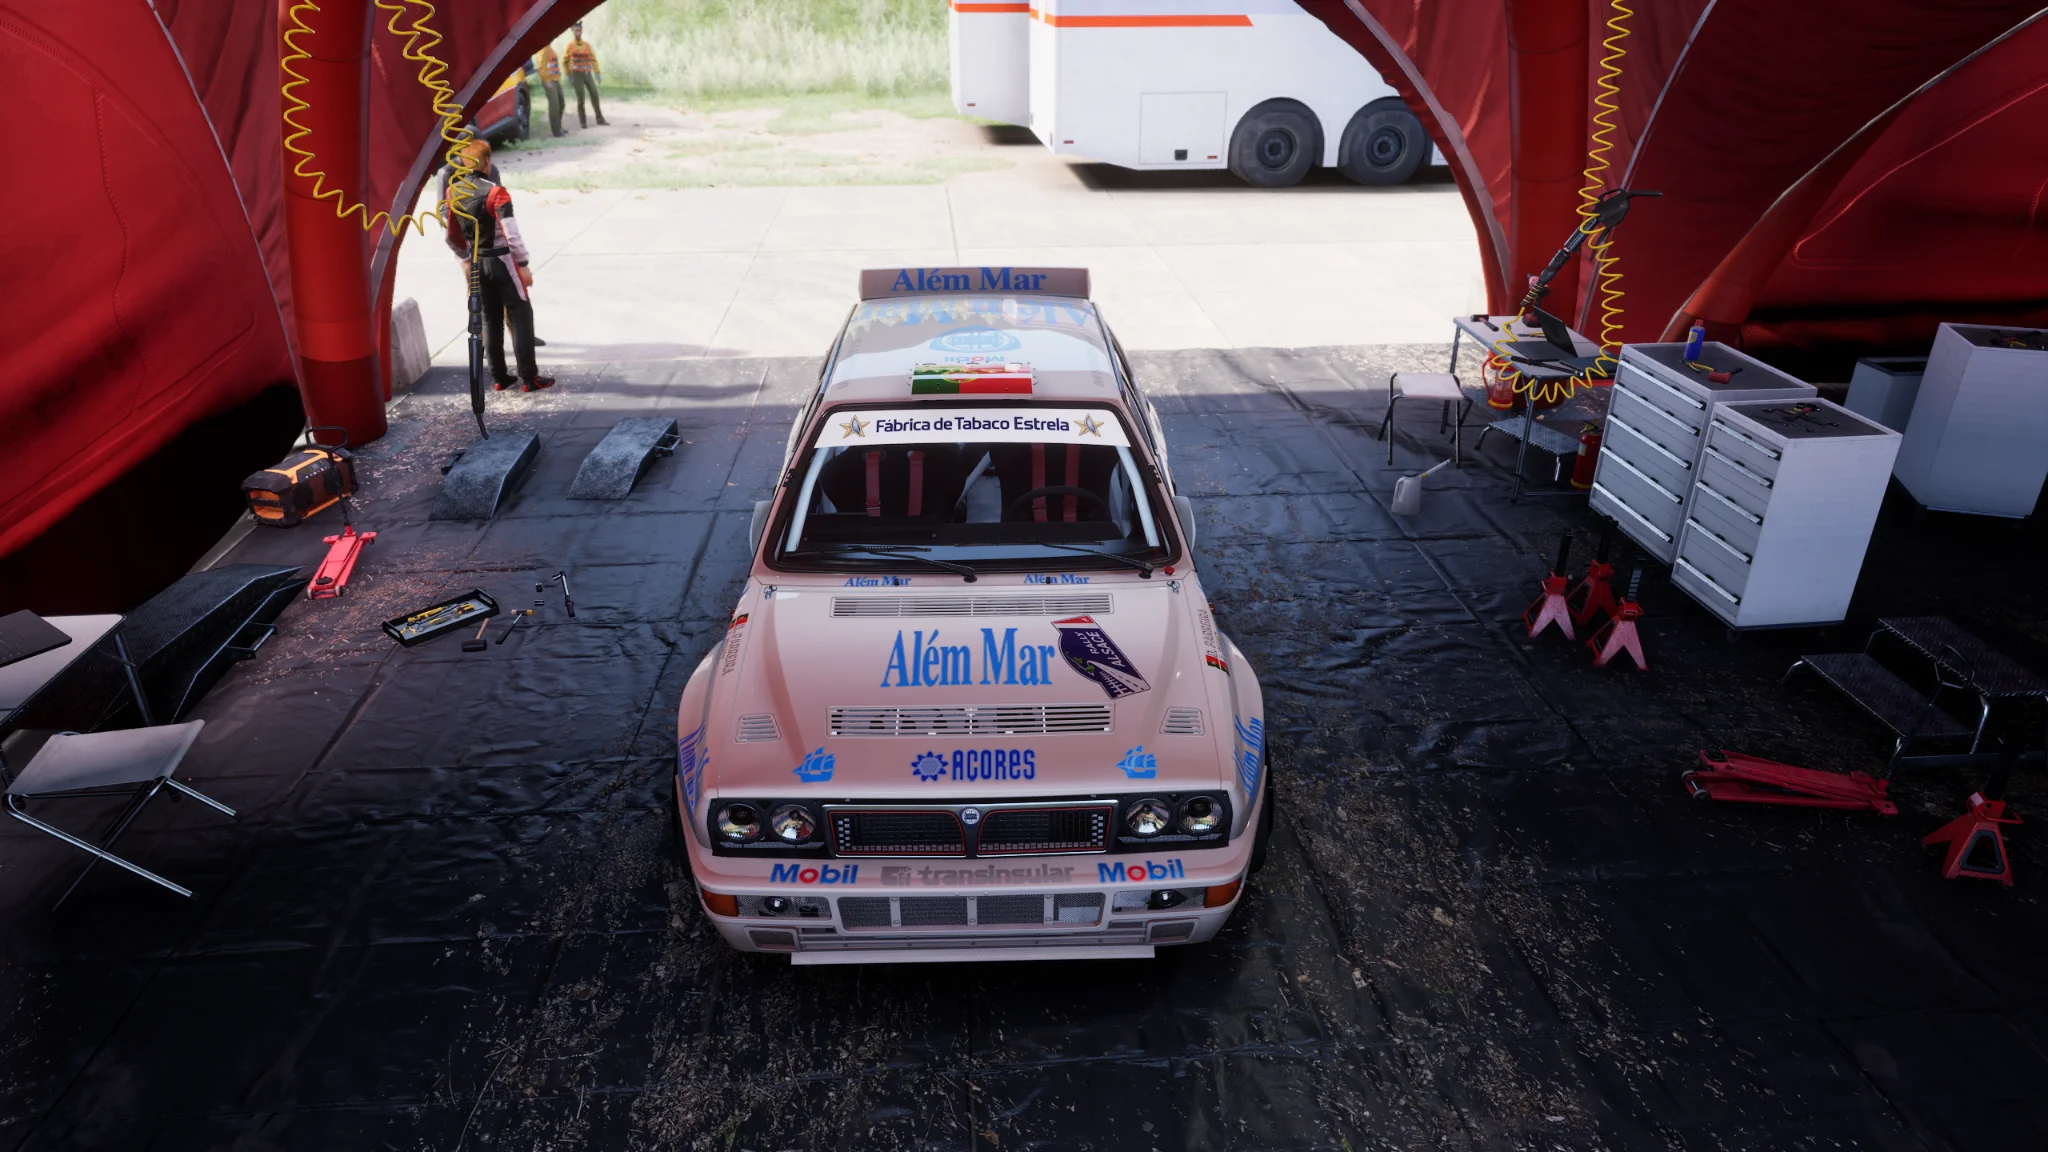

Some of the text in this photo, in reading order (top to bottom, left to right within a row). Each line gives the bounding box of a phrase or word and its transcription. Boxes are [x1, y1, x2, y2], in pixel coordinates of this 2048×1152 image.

[891, 266, 1047, 291] Além Mar
[875, 416, 1070, 433] Fábrica de Tabaco Estrela
[844, 575, 879, 587] Além
[1060, 573, 1090, 585] Mar
[1074, 631, 1100, 655] RALLY
[1086, 631, 1127, 668] ALSACE
[880, 628, 1056, 687] Além Mar
[770, 863, 859, 885] Mobil
[916, 863, 1075, 886] transinsular
[1097, 858, 1185, 883] Mobil
